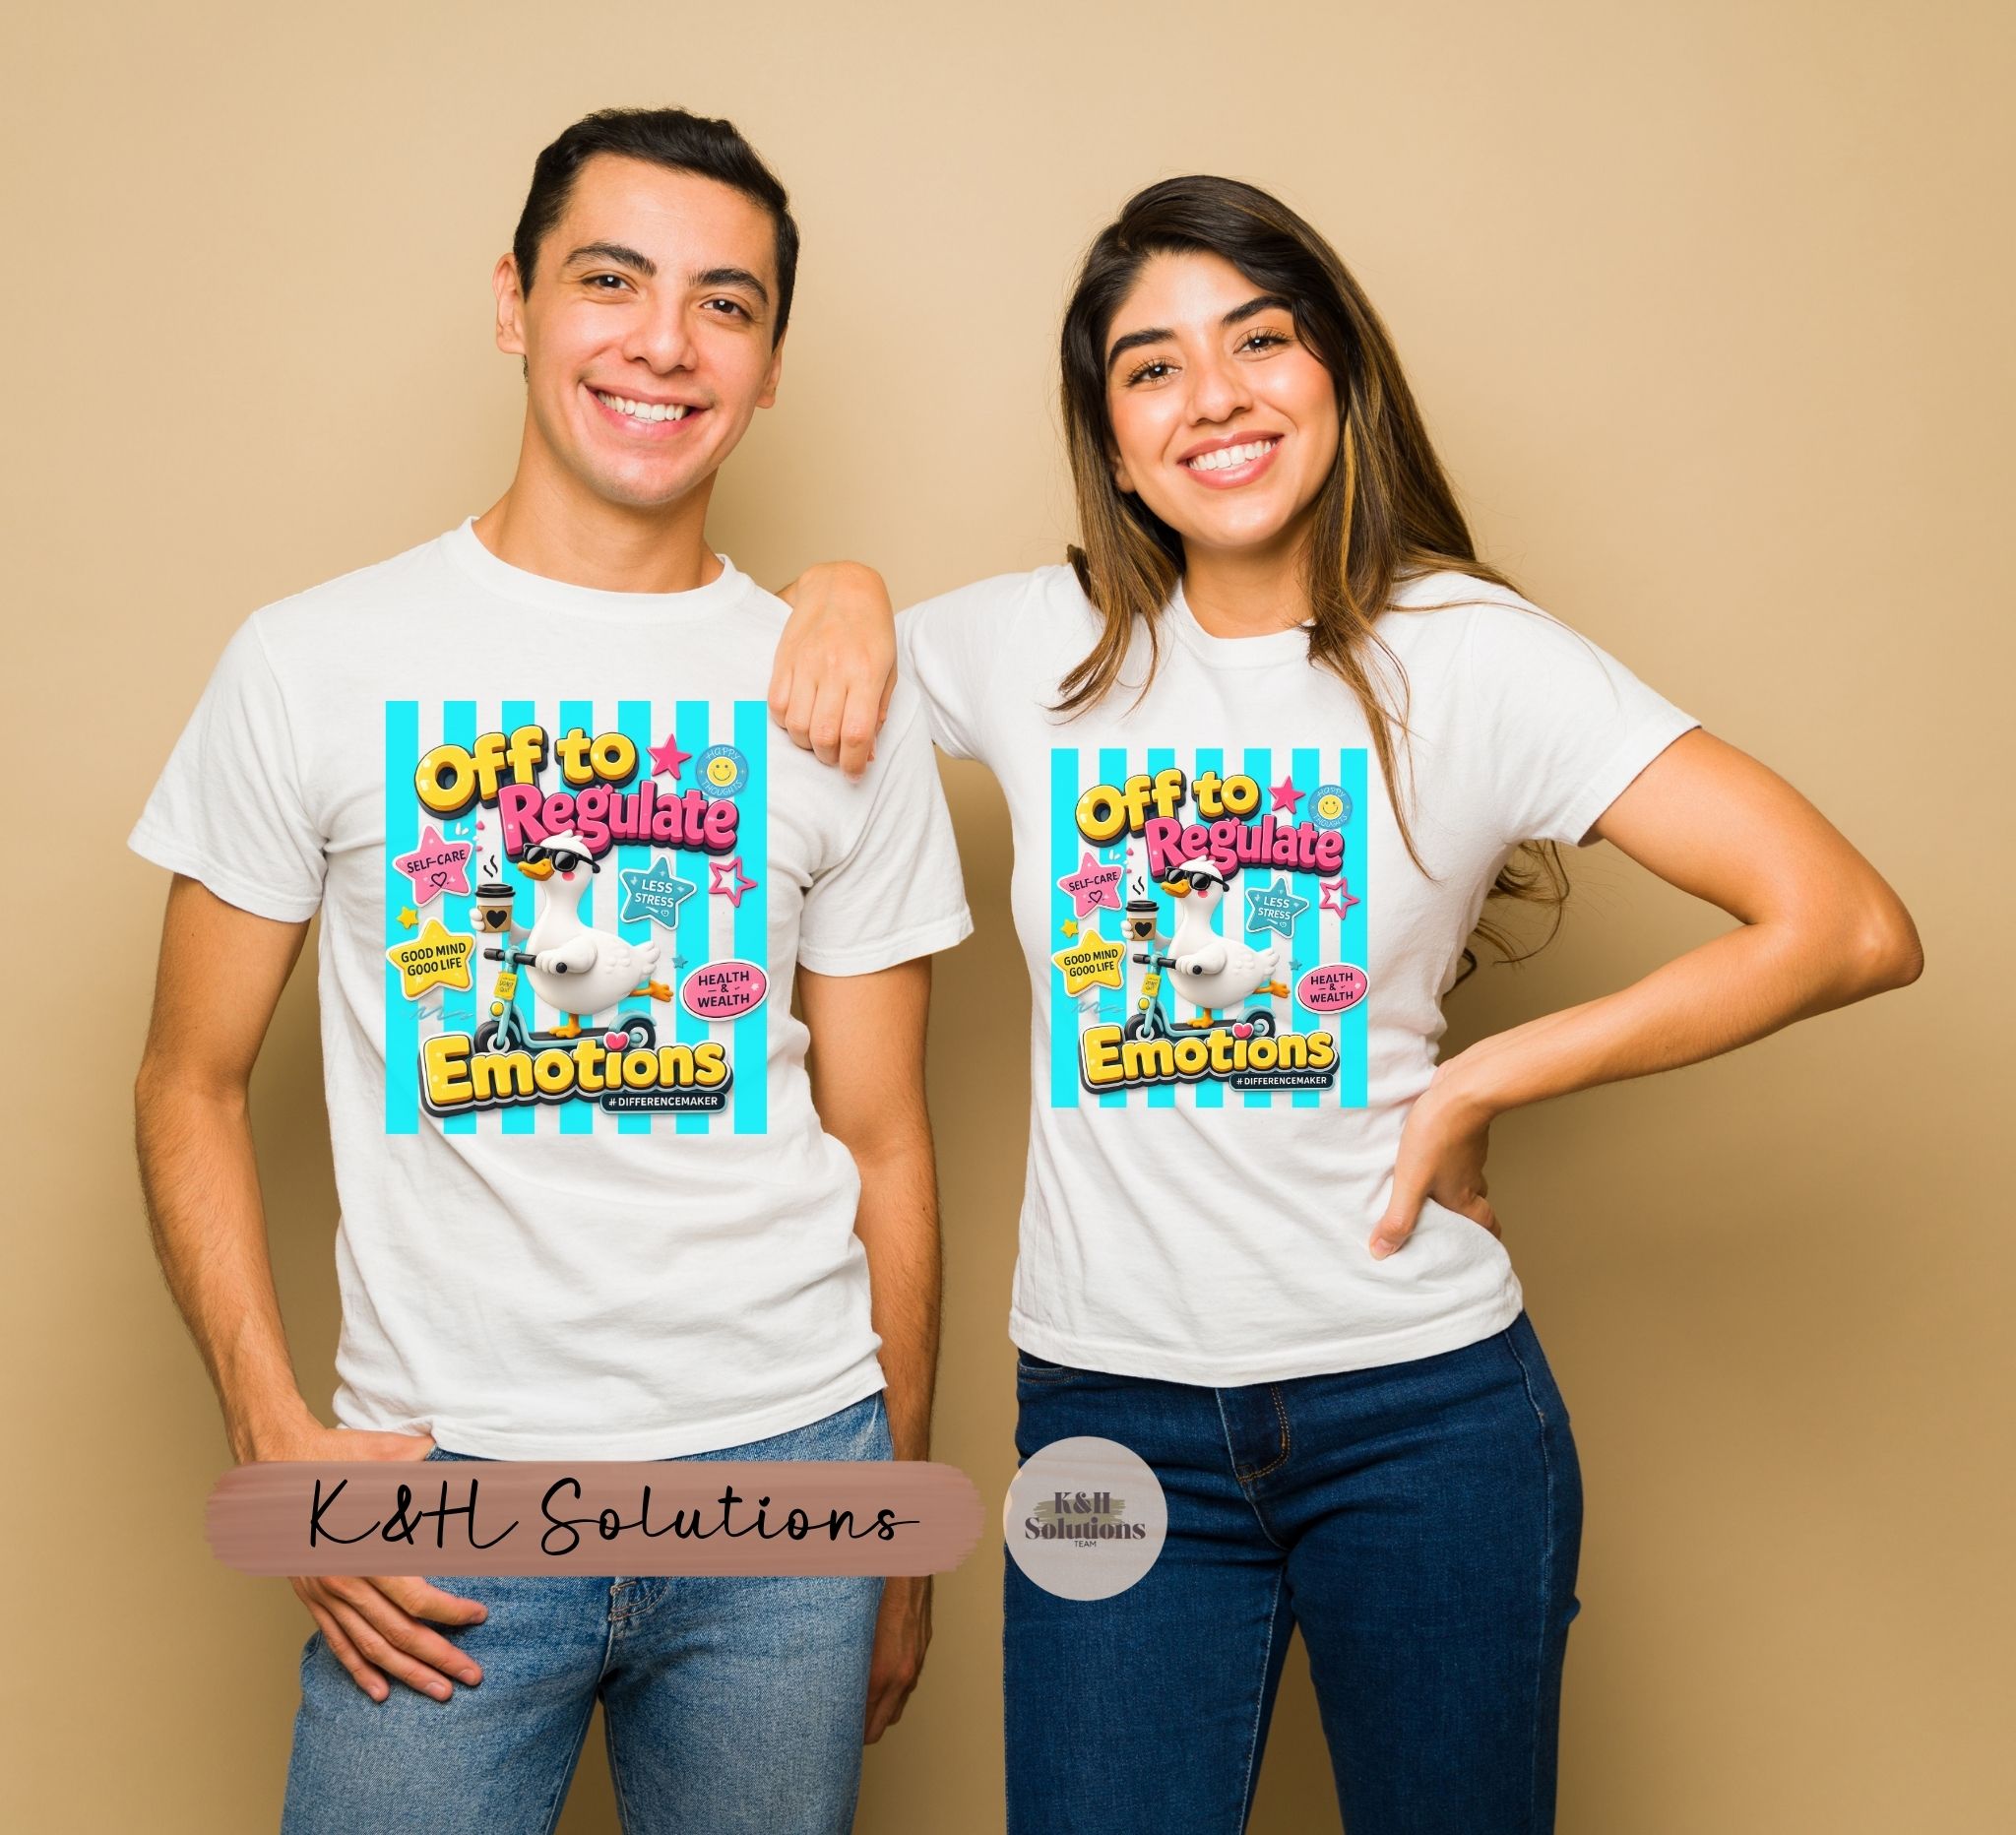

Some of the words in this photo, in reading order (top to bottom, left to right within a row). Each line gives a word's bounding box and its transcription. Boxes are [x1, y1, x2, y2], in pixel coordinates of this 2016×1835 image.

[705, 747, 740, 759] HAPPY
[414, 725, 547, 818] Off
[555, 728, 638, 787] to
[1075, 768, 1186, 846] Off
[1192, 771, 1262, 821] to
[497, 780, 739, 858] Regulate
[1145, 814, 1345, 880] Regulate
[407, 850, 467, 873] SELF-CARE
[641, 879, 673, 894] LESS
[1068, 871, 1119, 892] SELF-CARE
[635, 892, 674, 908] STRESS
[1263, 896, 1291, 909] LESS
[1257, 907, 1292, 920] STRESS
[401, 947, 434, 963] GOOD
[435, 942, 467, 957] MIND
[1064, 953, 1092, 966] GOOD
[1093, 949, 1118, 961] MIND
[440, 957, 463, 971] LIFE
[1097, 961, 1115, 973] LIFE
[698, 970, 750, 986] HEALTH
[1310, 972, 1354, 985] HEALTH
[721, 983, 729, 993] &
[1329, 982, 1337, 991] &
[697, 992, 750, 1008] WEALTH
[1309, 990, 1354, 1003] WEALTH
[1083, 1024, 1339, 1089] Emotions
[421, 1032, 730, 1110] Emotions
